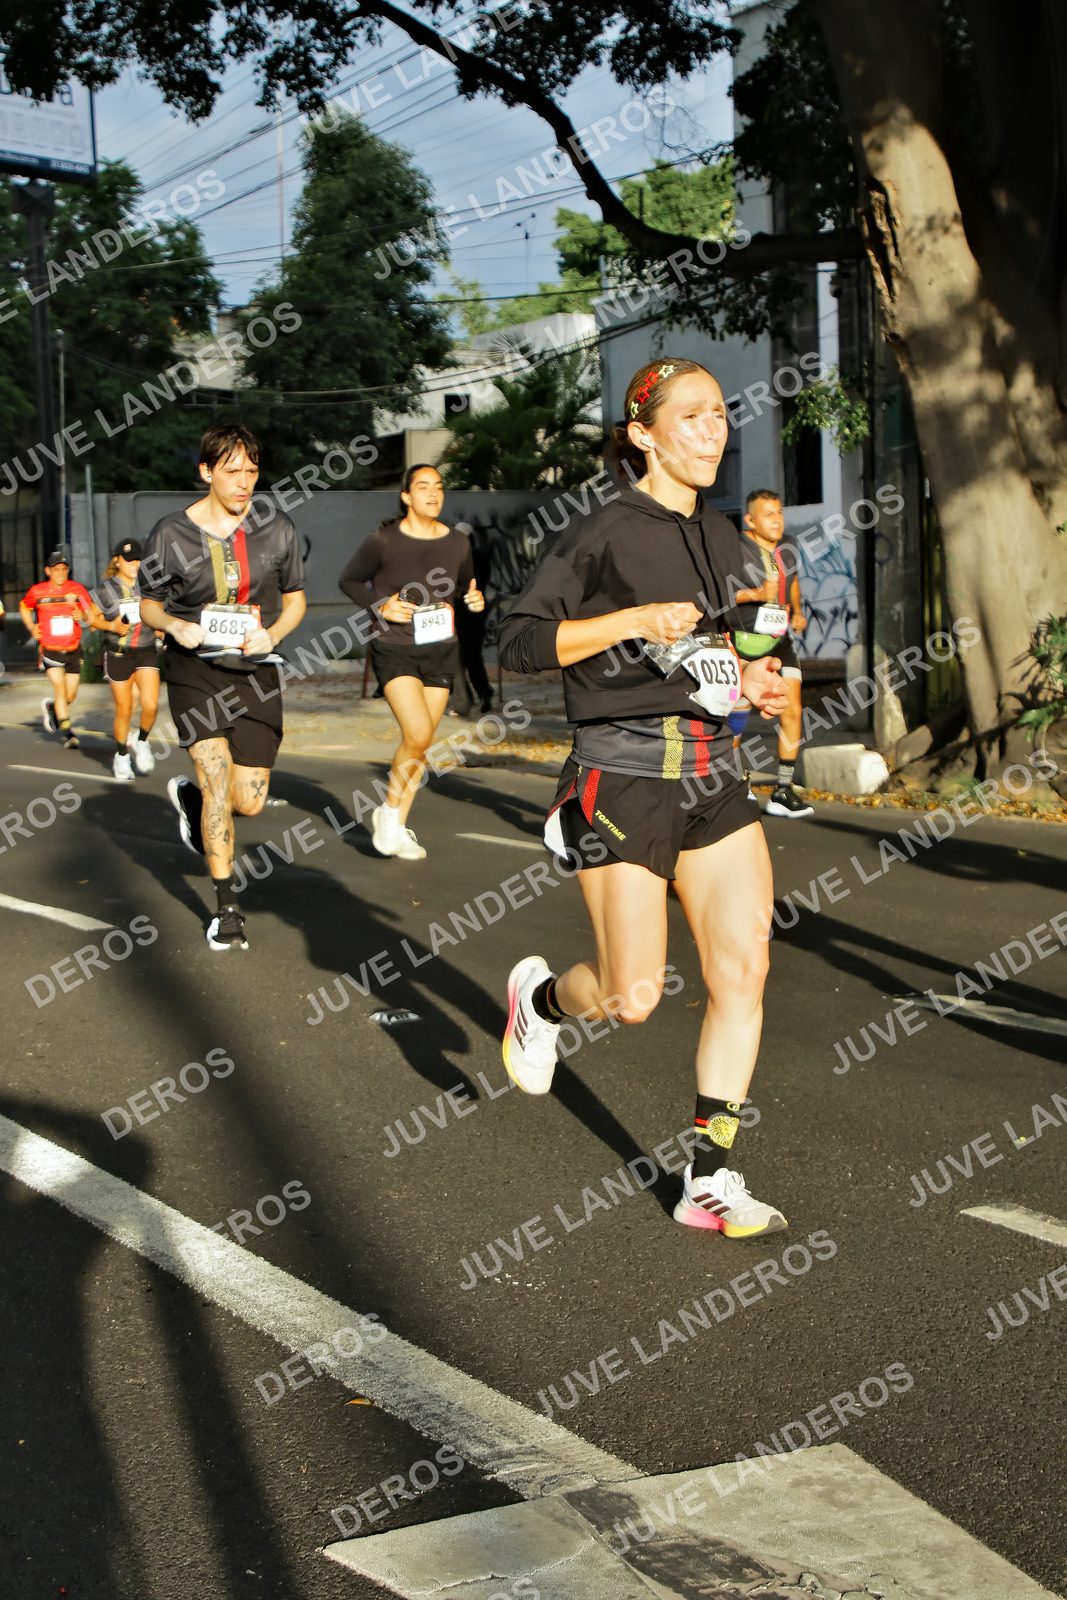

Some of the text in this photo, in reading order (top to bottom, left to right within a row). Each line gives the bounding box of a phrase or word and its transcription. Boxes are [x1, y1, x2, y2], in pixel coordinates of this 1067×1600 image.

[208, 617, 248, 636] 8685
[687, 658, 738, 687] 10253
[594, 809, 627, 841] TOPTIME
